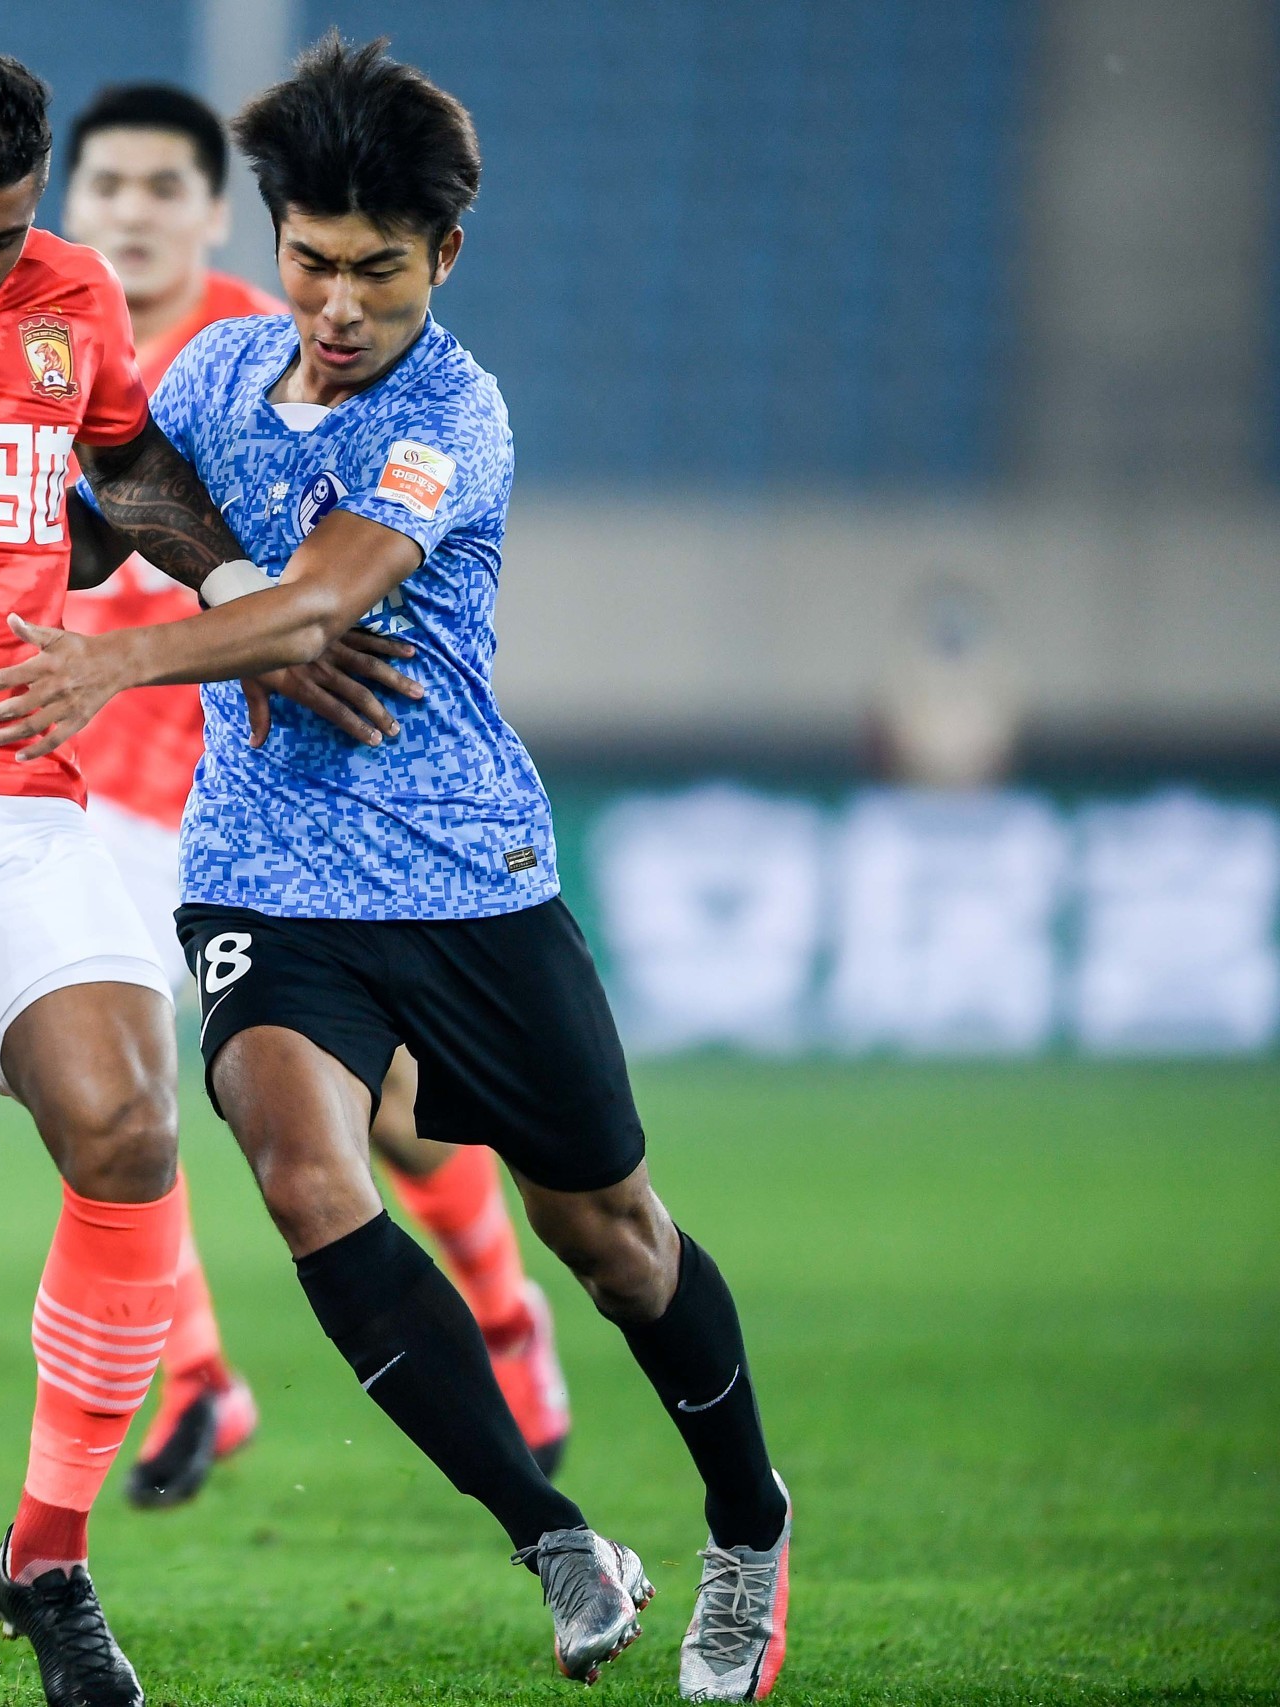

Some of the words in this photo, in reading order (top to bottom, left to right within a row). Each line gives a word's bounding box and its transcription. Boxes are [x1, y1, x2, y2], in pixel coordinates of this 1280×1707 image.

[422, 463, 438, 477] CSL
[391, 468, 438, 496] 中国平安
